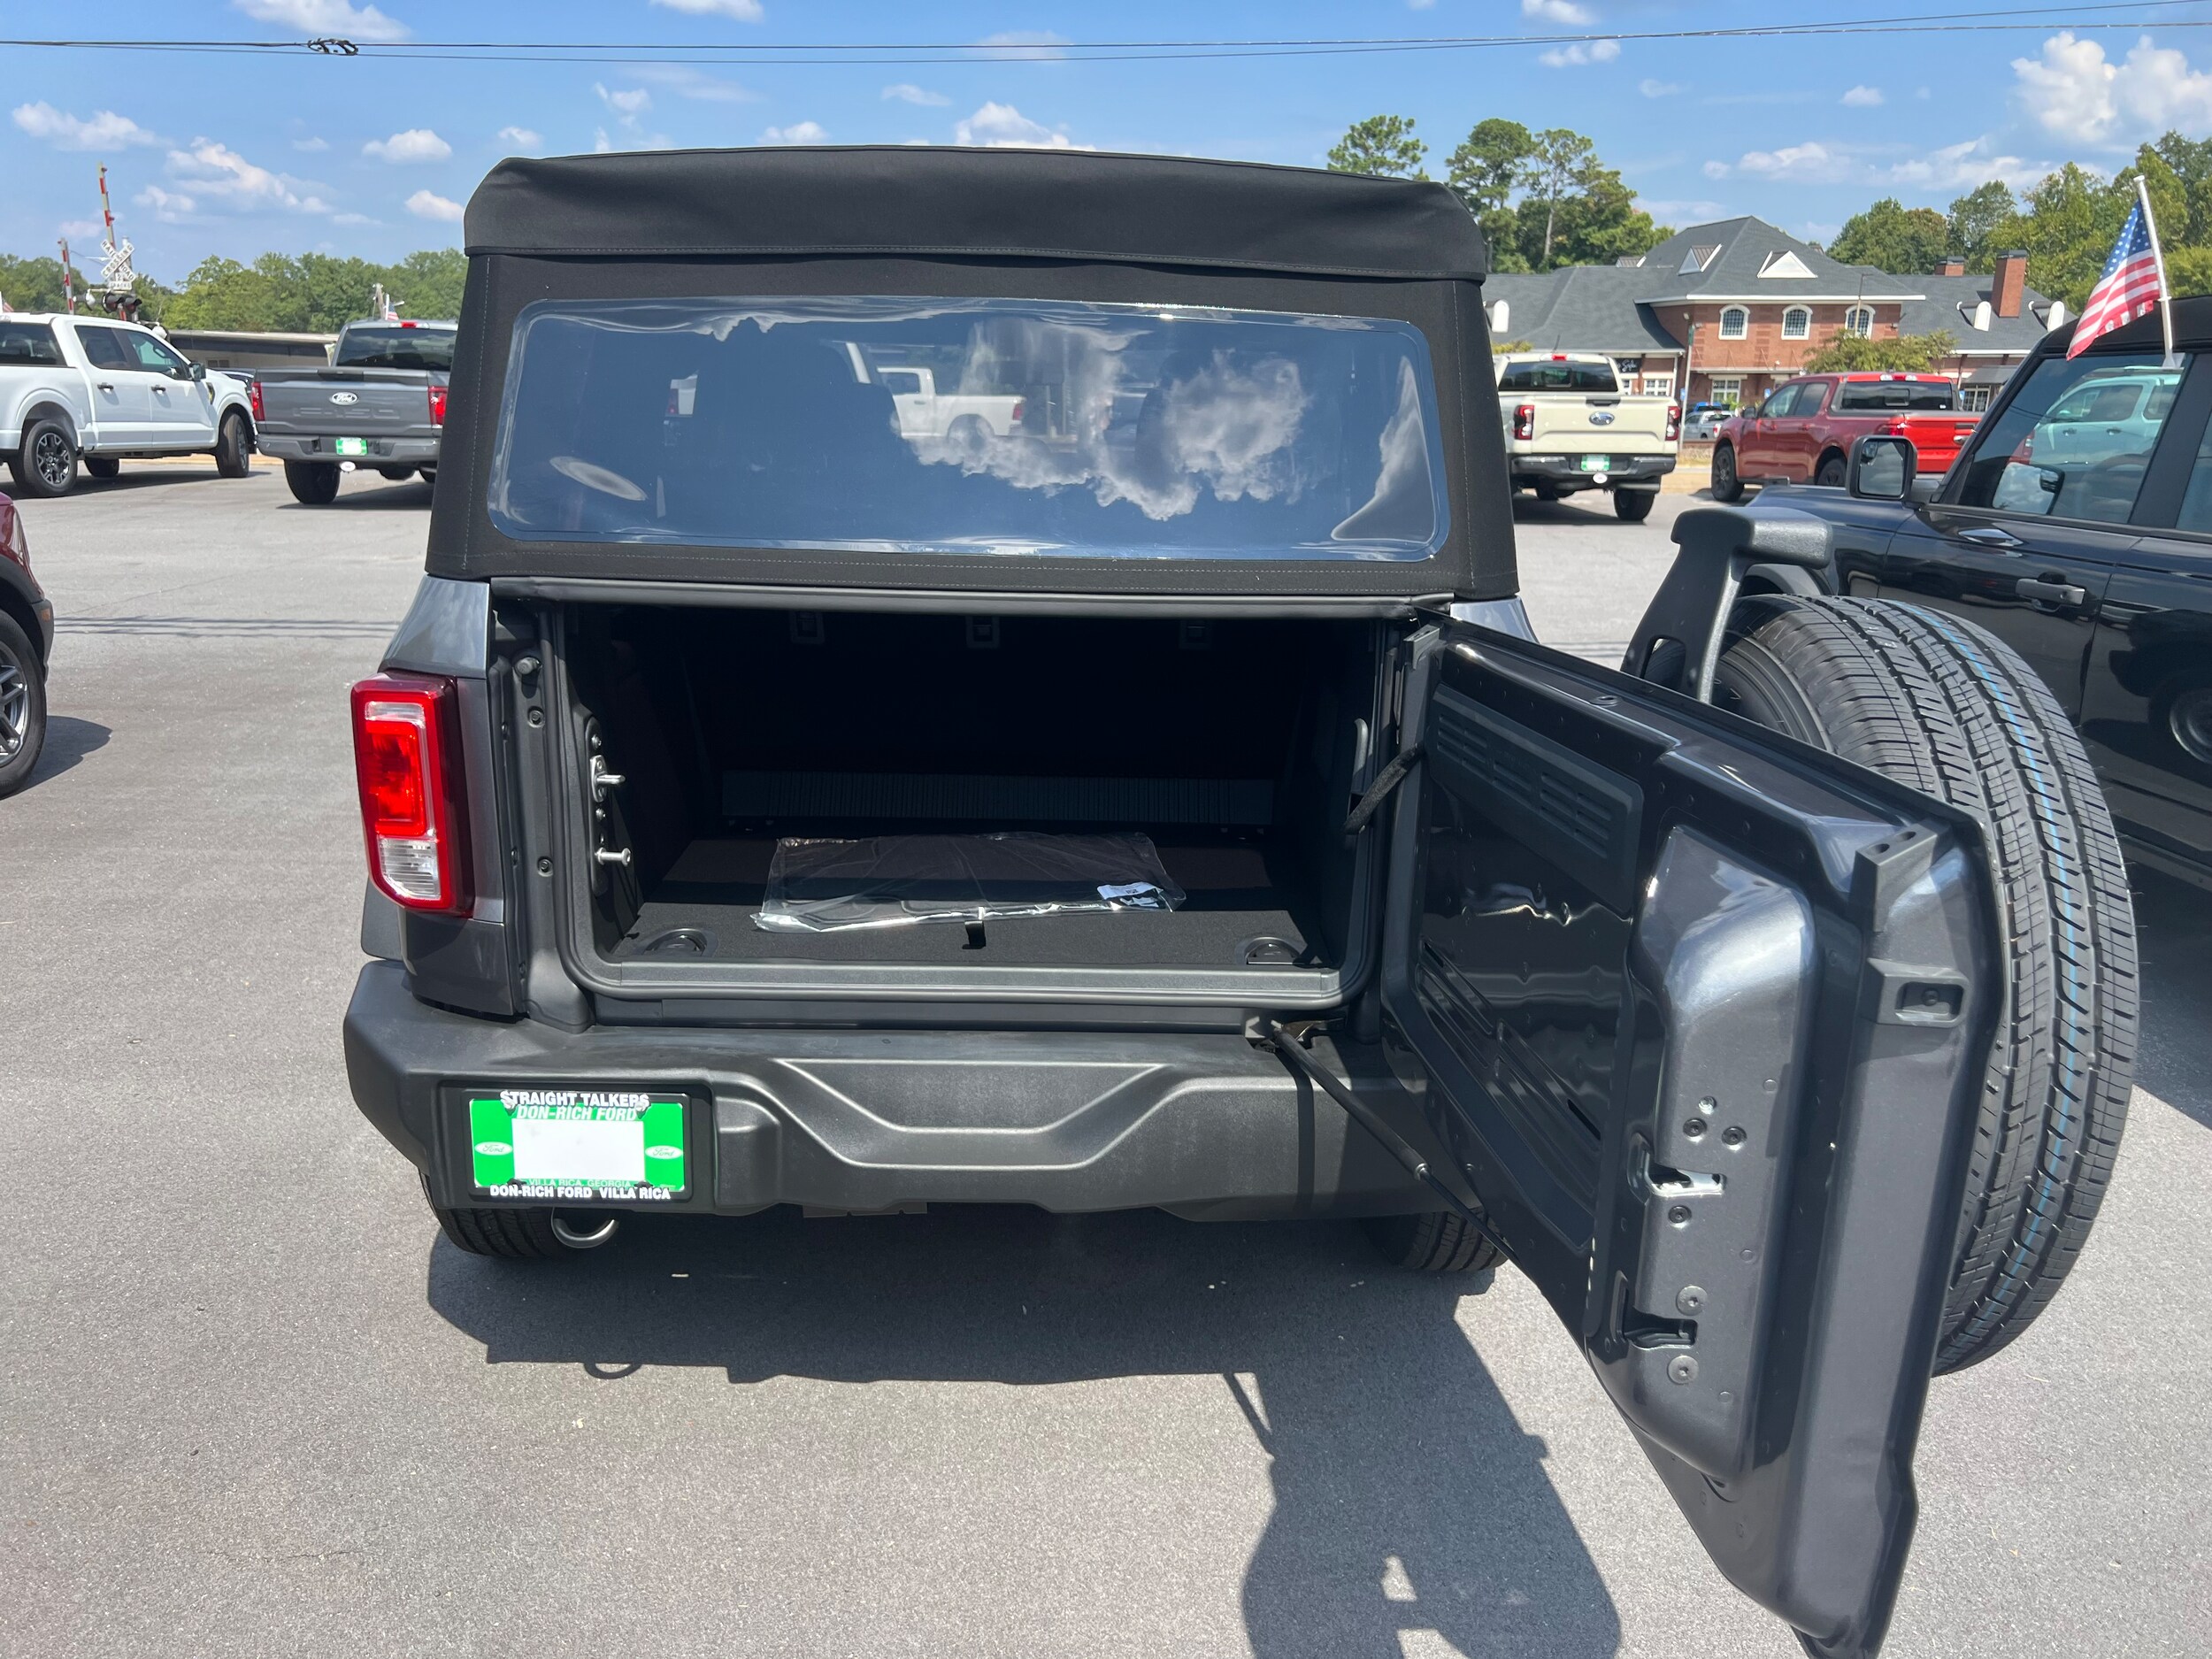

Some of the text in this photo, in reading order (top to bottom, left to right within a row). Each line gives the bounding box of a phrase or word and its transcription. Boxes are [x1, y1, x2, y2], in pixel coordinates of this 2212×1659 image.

[499, 1090, 650, 1109] STRAIGHT TALKERS
[516, 1105, 637, 1121] DON-RICH FORD
[529, 1178, 556, 1187] VILLA
[489, 1185, 672, 1200] DON-RICH FORD VILLA RICA
